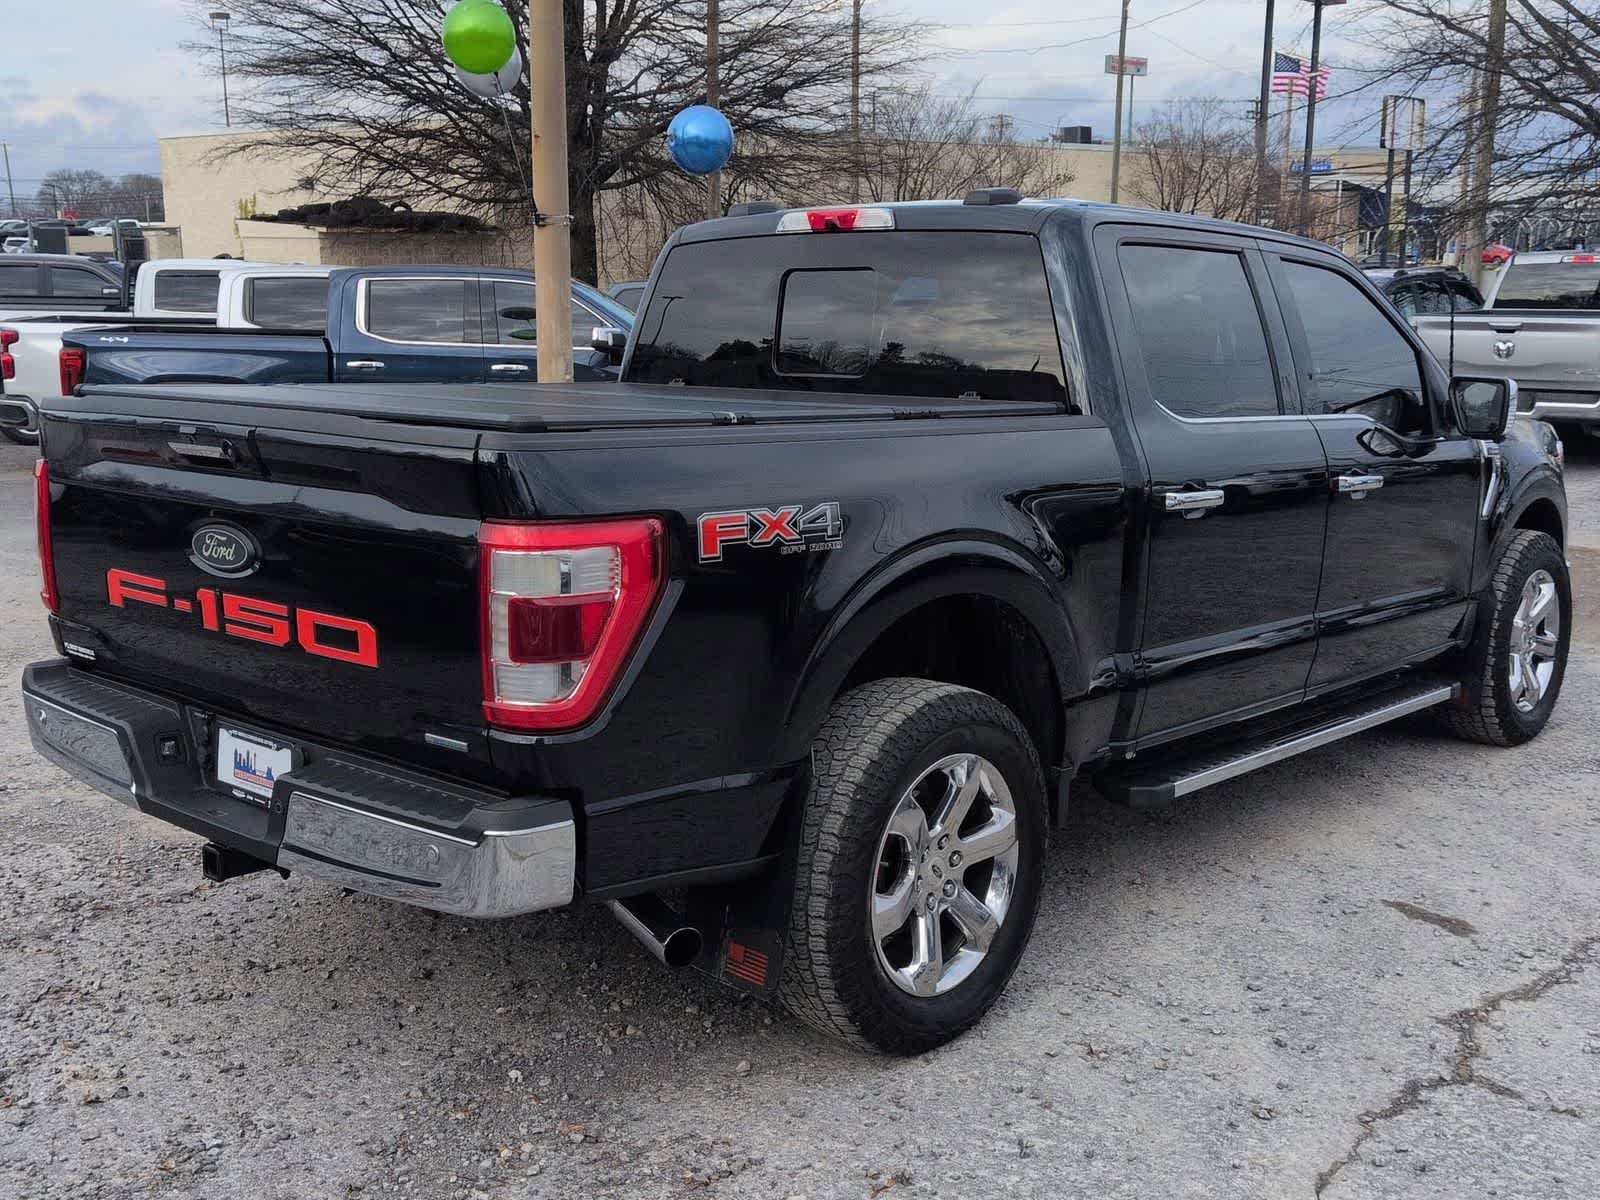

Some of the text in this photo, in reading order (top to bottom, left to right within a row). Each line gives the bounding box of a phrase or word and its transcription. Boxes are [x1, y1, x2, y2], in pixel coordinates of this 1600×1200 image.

[203, 533, 236, 560] Ford
[697, 502, 843, 563] FX4
[781, 541, 843, 554] OFF ROAD
[107, 568, 378, 668] F-150
